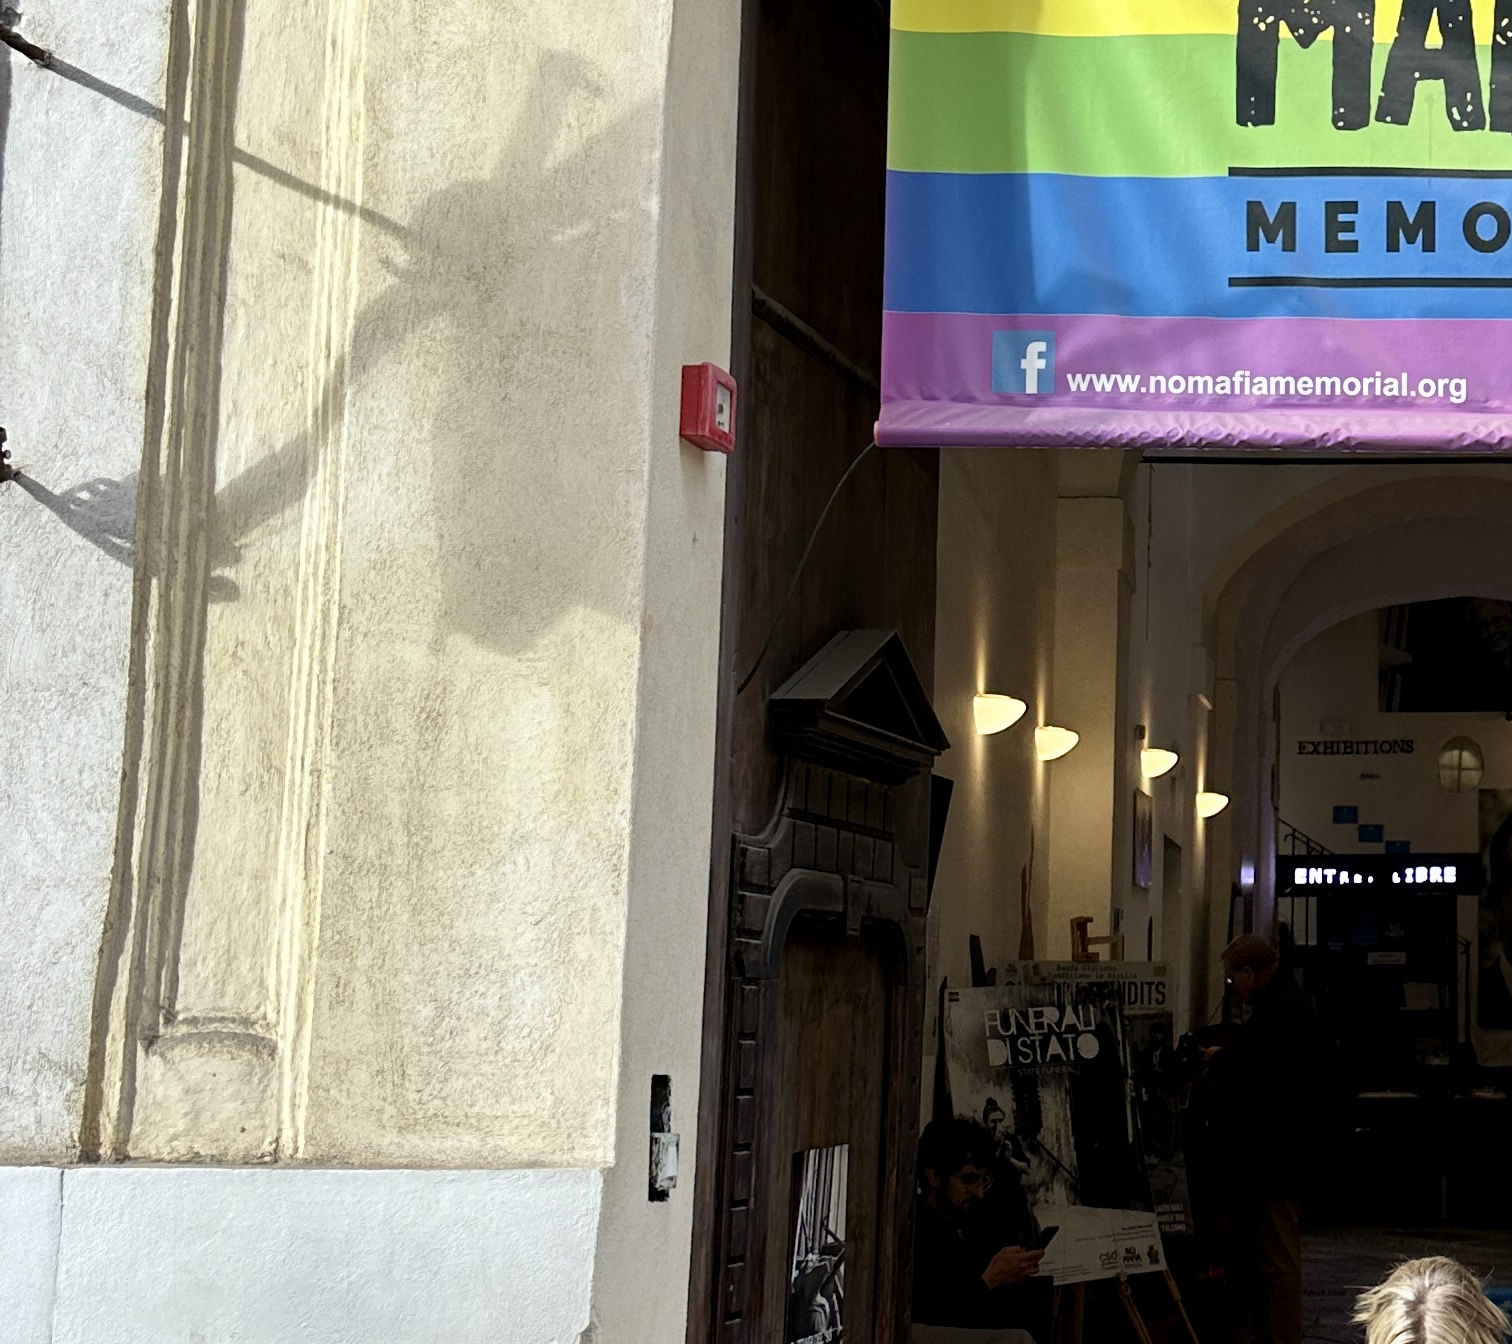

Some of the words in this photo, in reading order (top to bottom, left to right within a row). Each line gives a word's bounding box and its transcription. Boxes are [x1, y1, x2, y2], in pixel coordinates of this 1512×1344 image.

[1067, 370, 1468, 403] www.nomafiamemorial.org
[1297, 739, 1415, 755] EXHIBITIONS
[984, 1004, 1096, 1038] FUNERALI
[987, 1037, 1012, 1067] DI
[1016, 1032, 1100, 1064] STATO
